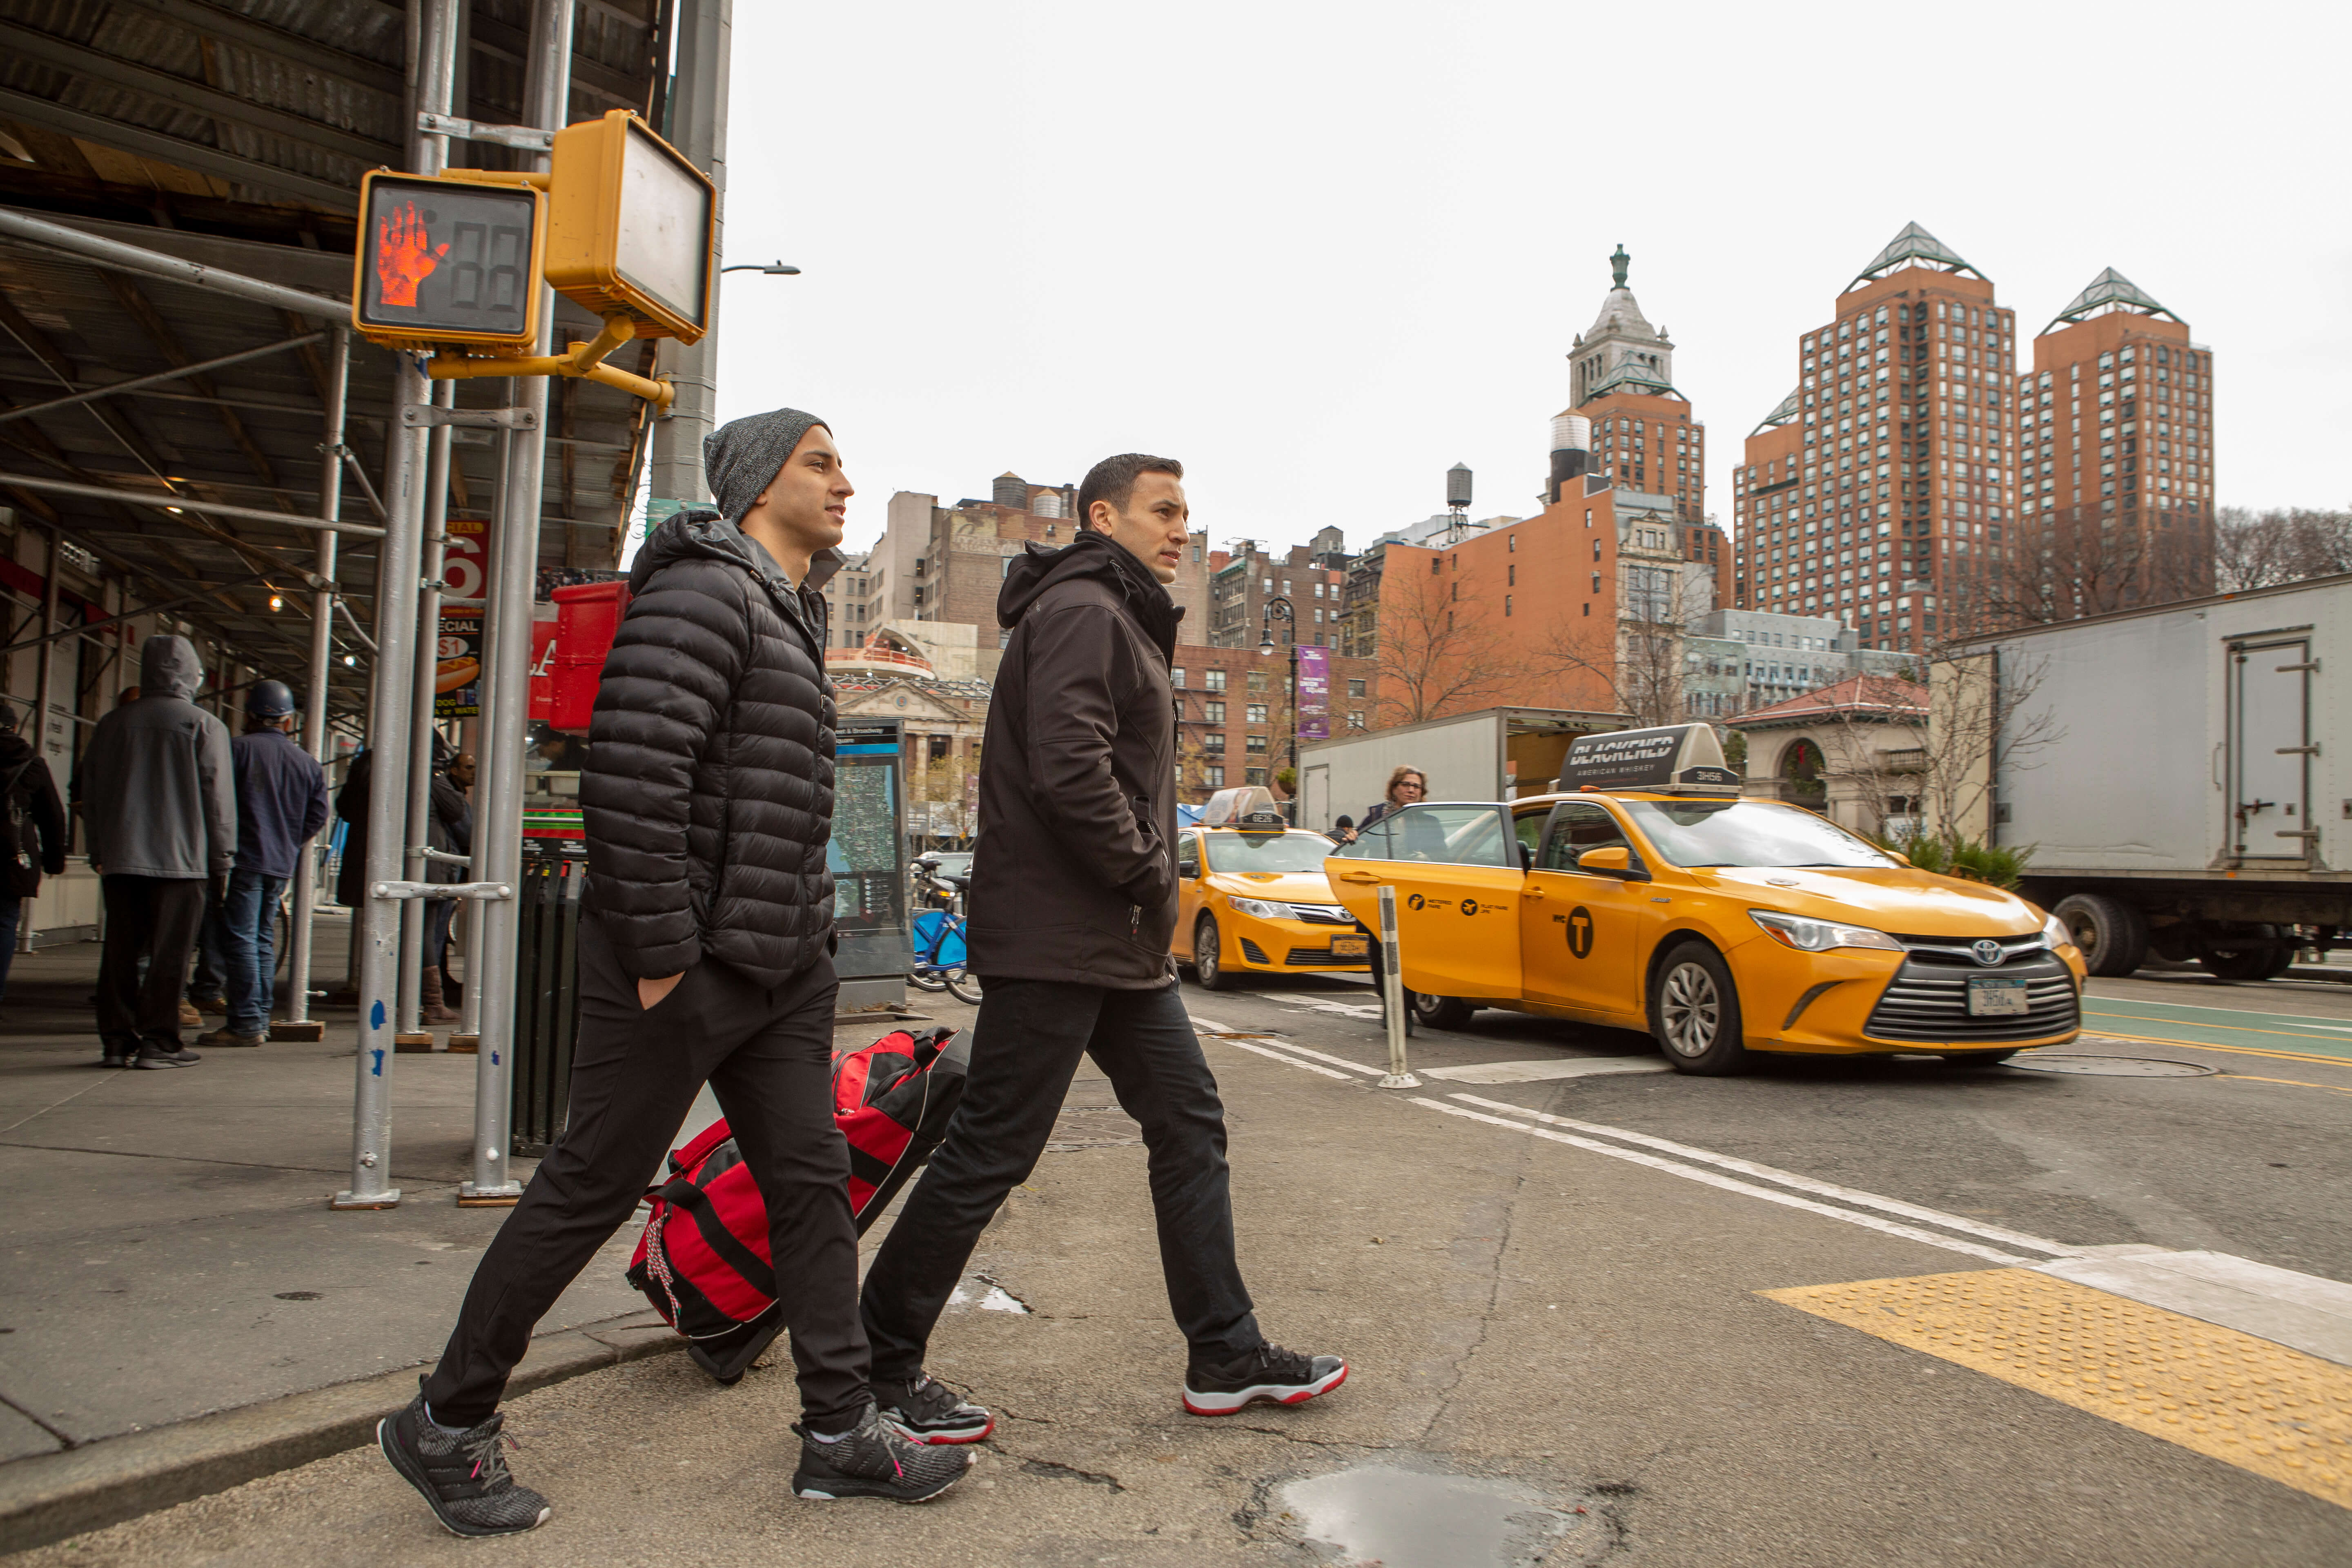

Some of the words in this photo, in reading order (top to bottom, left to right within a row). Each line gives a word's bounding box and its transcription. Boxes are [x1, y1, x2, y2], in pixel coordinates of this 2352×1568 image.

[1570, 736, 1674, 766] BLACKENED
[1576, 768, 1616, 776] AMERICAN
[1618, 764, 1655, 773] WHISKEY
[1696, 771, 1723, 782] 3H56
